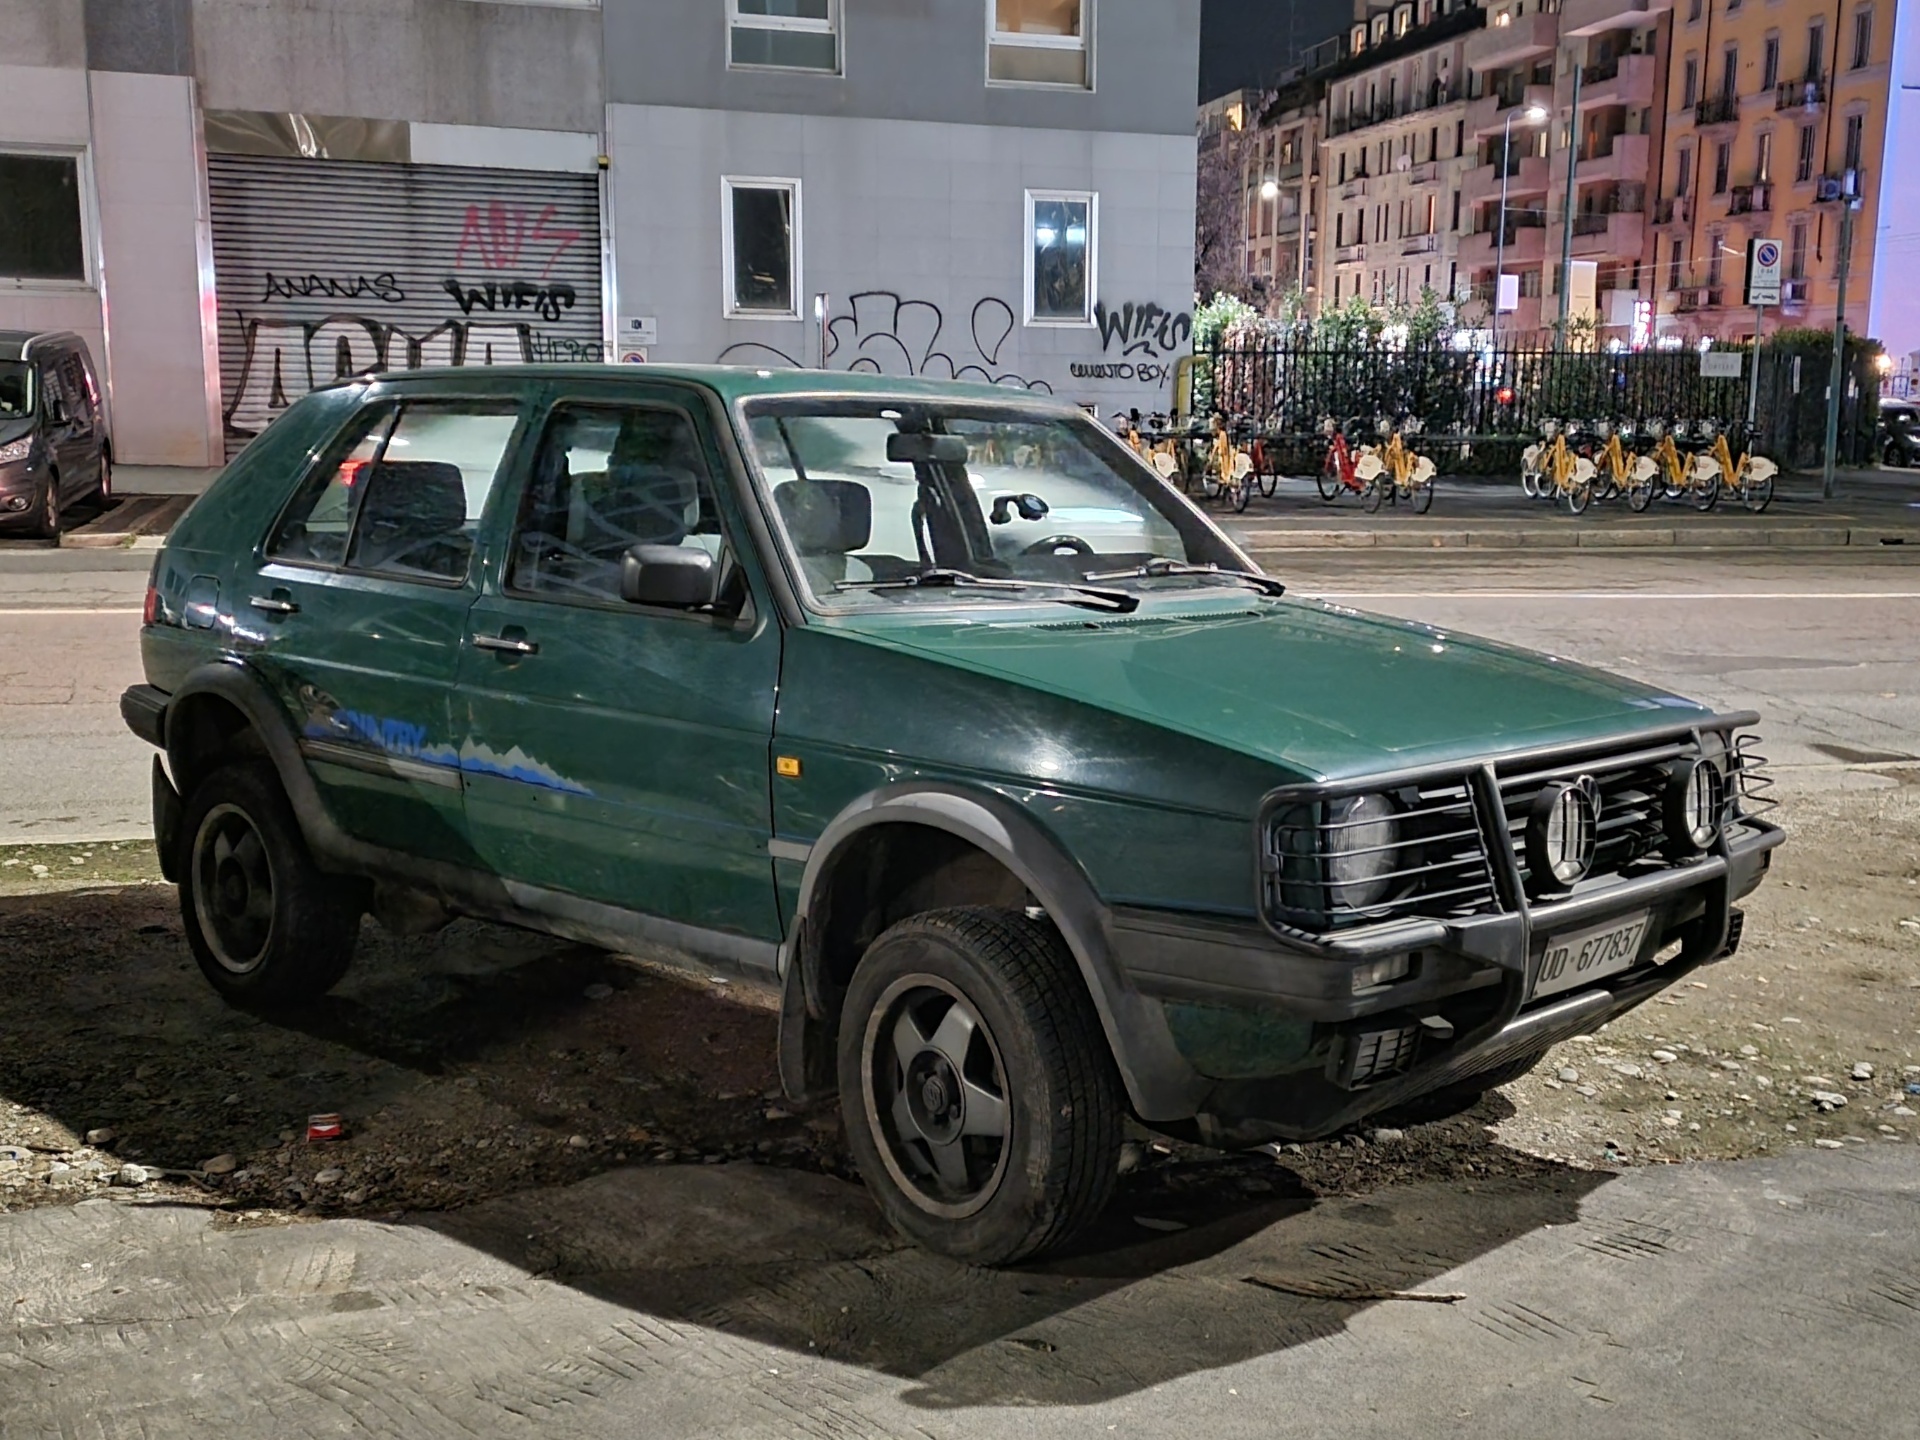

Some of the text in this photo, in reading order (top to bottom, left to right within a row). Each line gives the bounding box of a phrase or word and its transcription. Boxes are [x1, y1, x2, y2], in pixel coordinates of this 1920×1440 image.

[262, 272, 405, 302] ANANAS
[1539, 922, 1644, 983] UD 677837
